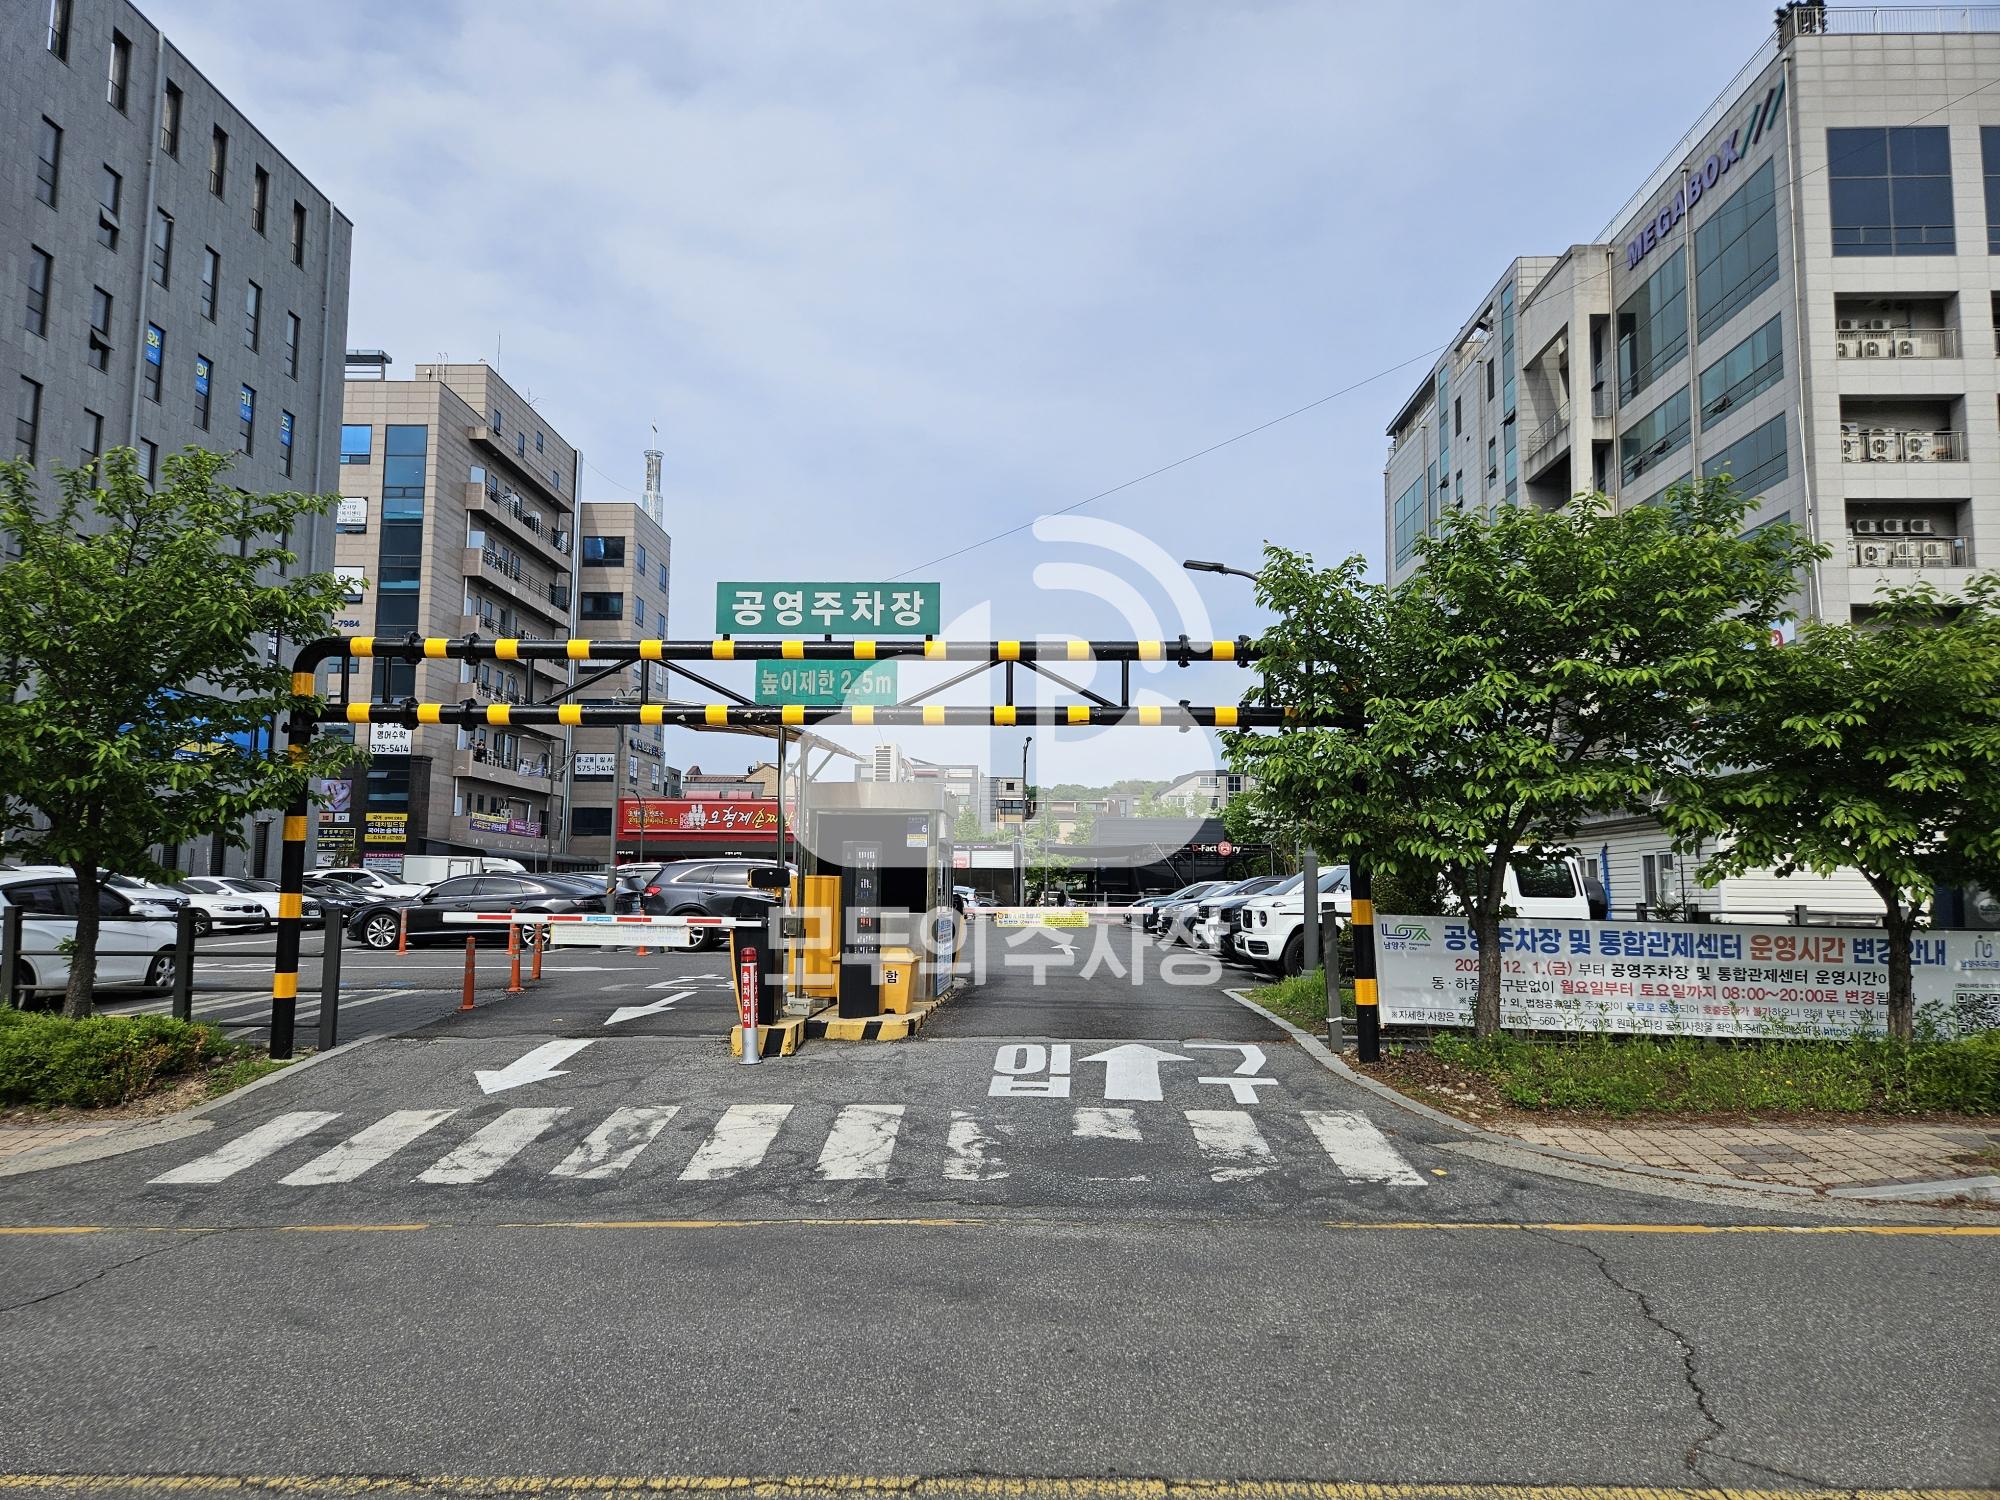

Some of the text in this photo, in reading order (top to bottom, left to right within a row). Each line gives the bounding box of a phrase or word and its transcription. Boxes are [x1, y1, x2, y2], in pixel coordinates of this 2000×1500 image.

[1627, 128, 1741, 272] MEGABOX
[732, 591, 925, 627] 공영주차장
[761, 669, 892, 695] 높이제한 2.5m
[377, 730, 406, 740] 영어수학
[371, 744, 409, 753] 575-5414
[708, 806, 754, 828] 오형제
[1383, 941, 1407, 950] 남양주
[1568, 929, 1591, 955] 및
[1599, 929, 1742, 960] 통합관제센터
[1750, 934, 1845, 963] 운영시간
[886, 970, 898, 984] 함
[1578, 963, 1605, 976] 부터
[1611, 963, 1689, 980] 공영주차장
[1697, 966, 1710, 980] 및
[1717, 967, 1808, 984] 통합관제센터
[1501, 980, 1554, 994] 구분없이
[1560, 980, 1633, 996] 월요일부터
[1639, 983, 1717, 1000] 토요일까지
[1428, 1011, 1455, 1022] 사항은
[1526, 998, 1581, 1010] 법정공휴일은
[1627, 1001, 1655, 1012] 무료로
[1826, 1008, 1846, 1019] 부탁
[987, 1043, 1279, 1104] 입 구
